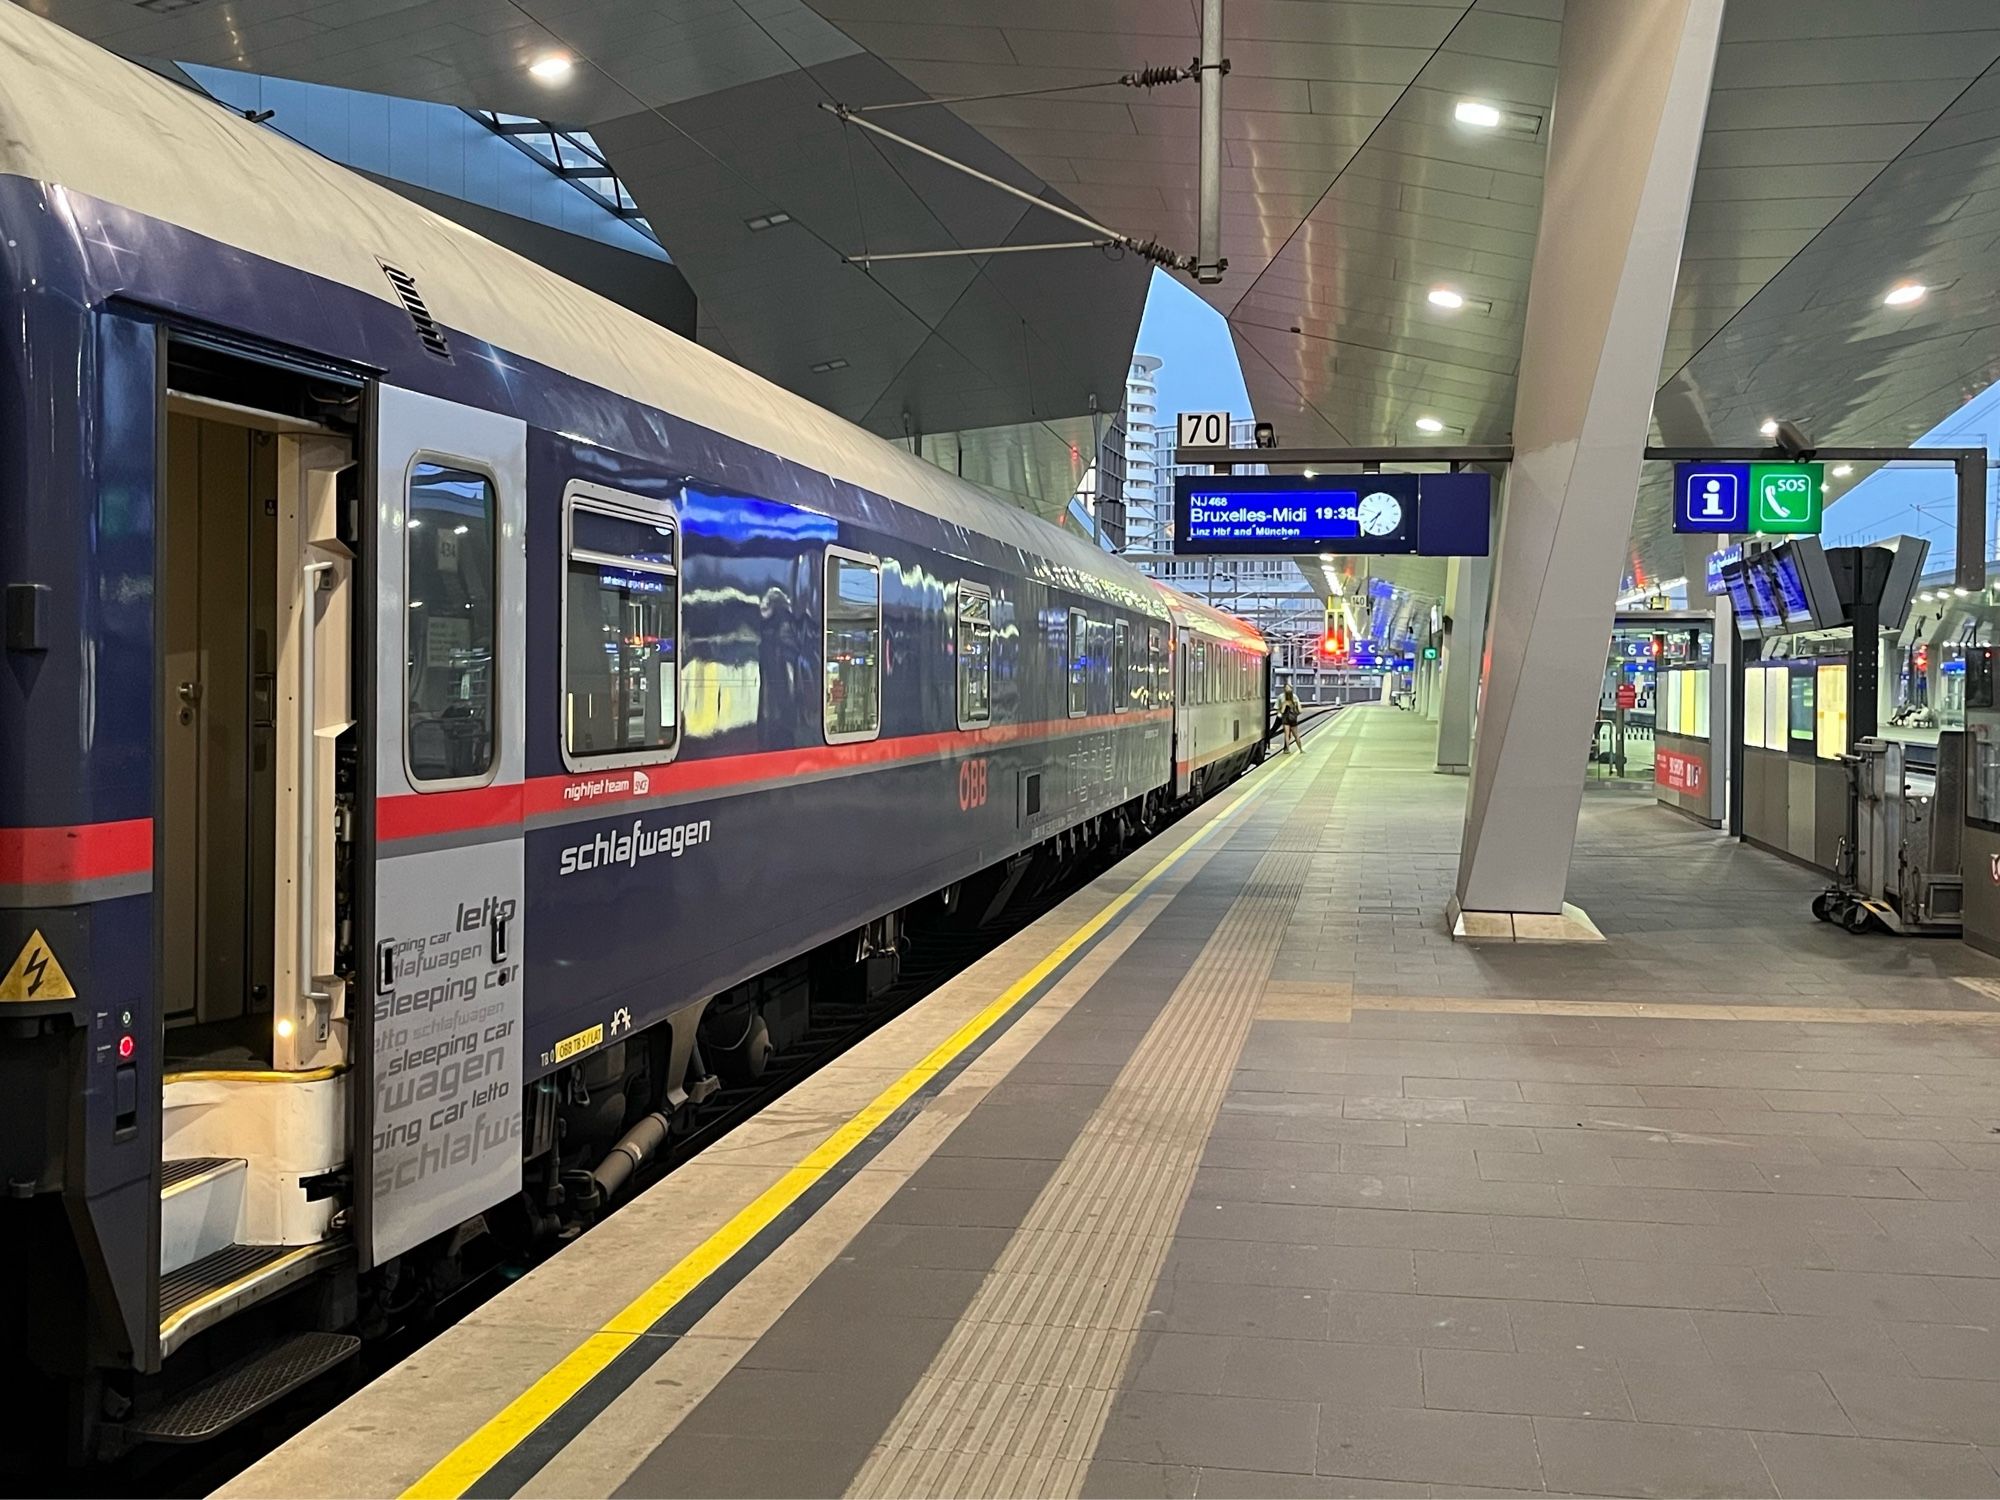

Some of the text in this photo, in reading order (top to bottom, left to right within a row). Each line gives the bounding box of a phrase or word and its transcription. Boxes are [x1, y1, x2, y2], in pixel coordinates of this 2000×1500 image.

[1188, 414, 1220, 443] 70
[1777, 479, 1806, 492] SOS
[1191, 507, 1307, 522] Bruxelles-Midi
[1190, 526, 1300, 536] Linz Hbf and München
[1627, 644, 1637, 655] 6
[563, 779, 630, 801] nightjet team
[559, 819, 711, 876] schlafwagen
[456, 895, 517, 933] letto
[429, 931, 452, 946] car
[374, 964, 519, 1022] sleeping car
[413, 1001, 504, 1040] schlafwagen
[388, 1020, 515, 1077] sleeping car
[429, 1100, 468, 1131] car
[471, 1081, 509, 1109] letto
